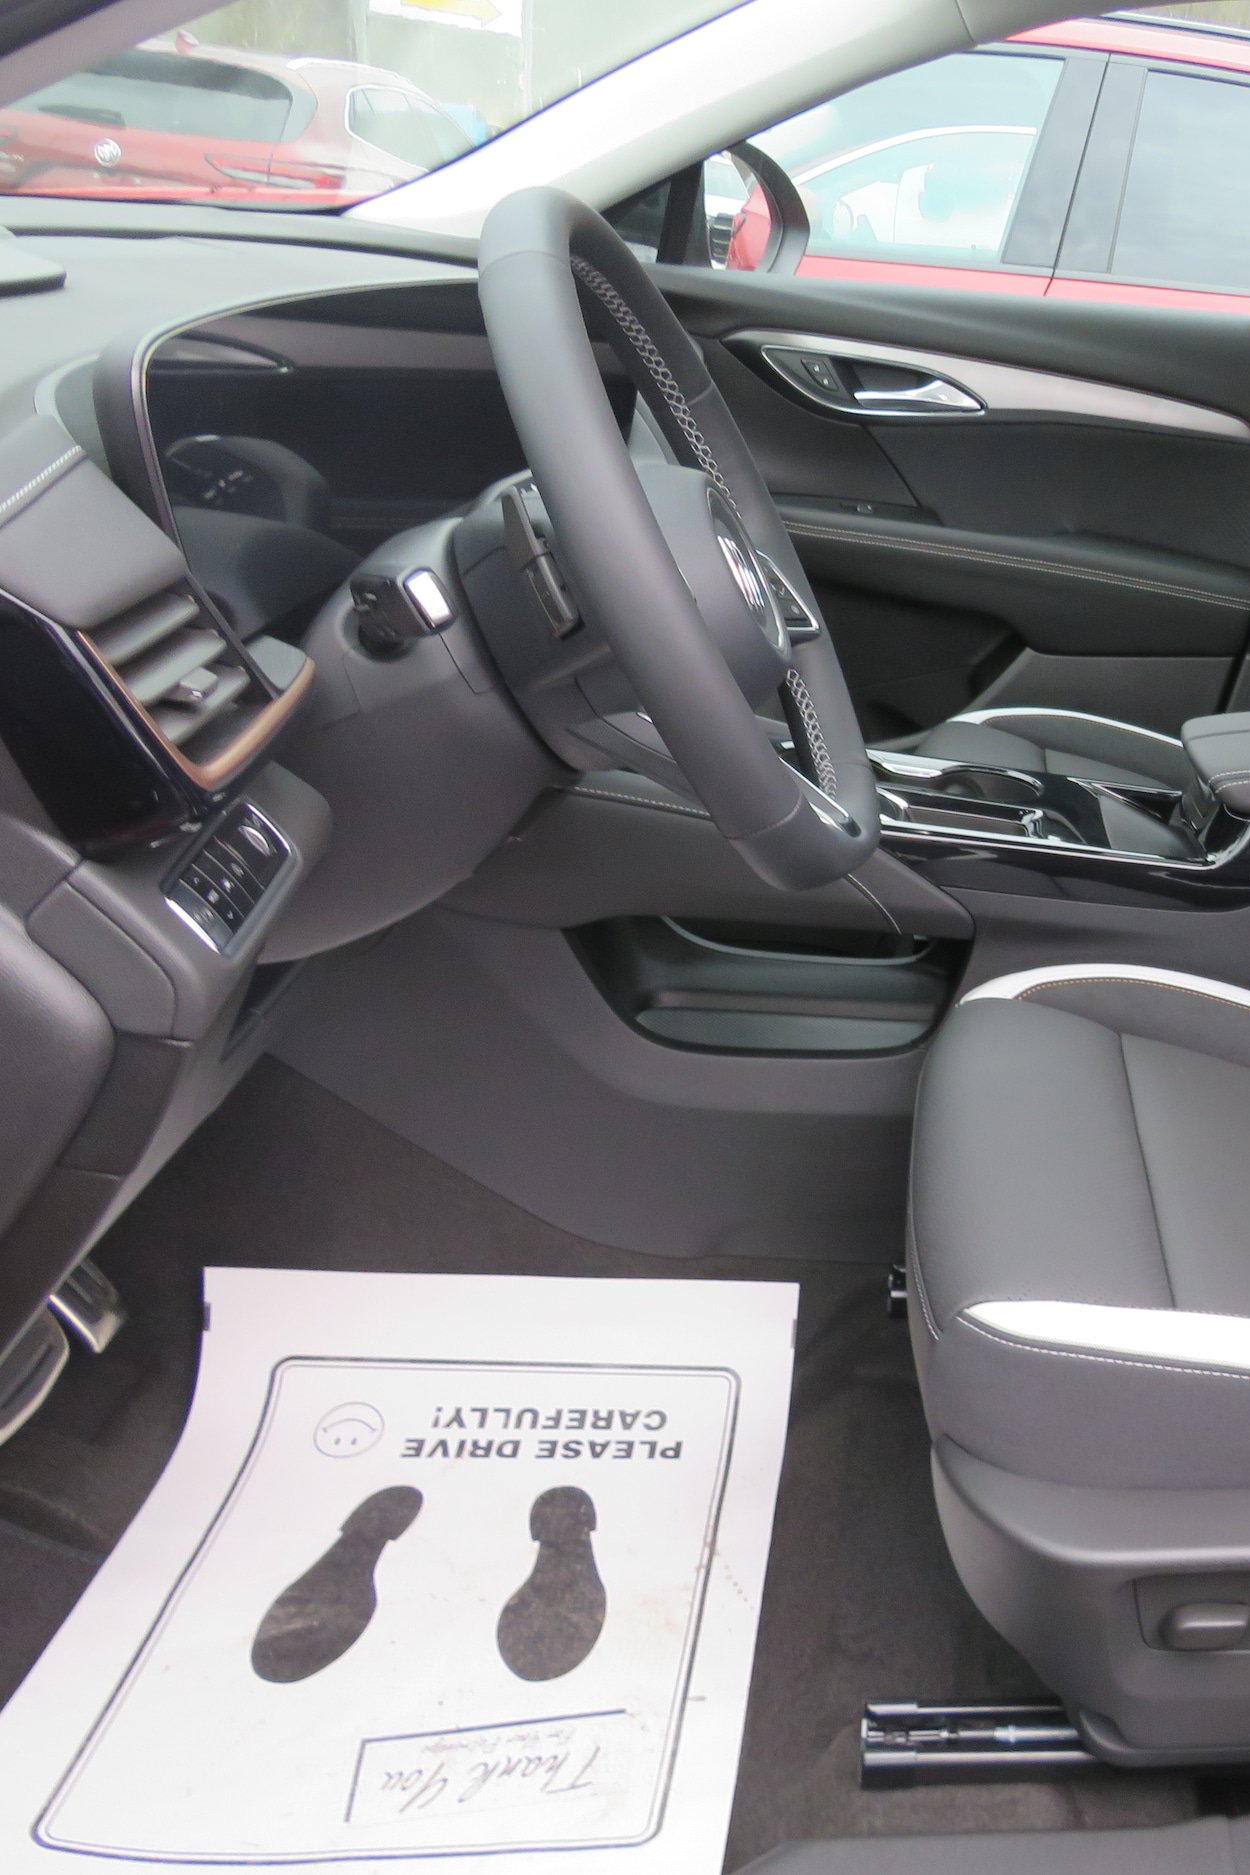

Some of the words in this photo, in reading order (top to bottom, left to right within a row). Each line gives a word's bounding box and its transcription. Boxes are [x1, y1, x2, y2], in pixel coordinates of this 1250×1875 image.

[431, 1406, 668, 1431] CAREFULLY!
[401, 1438, 523, 1459] DRIVE
[535, 1440, 683, 1460] PLEASE
[457, 1746, 600, 1803] Thank
[381, 1762, 448, 1813] You
